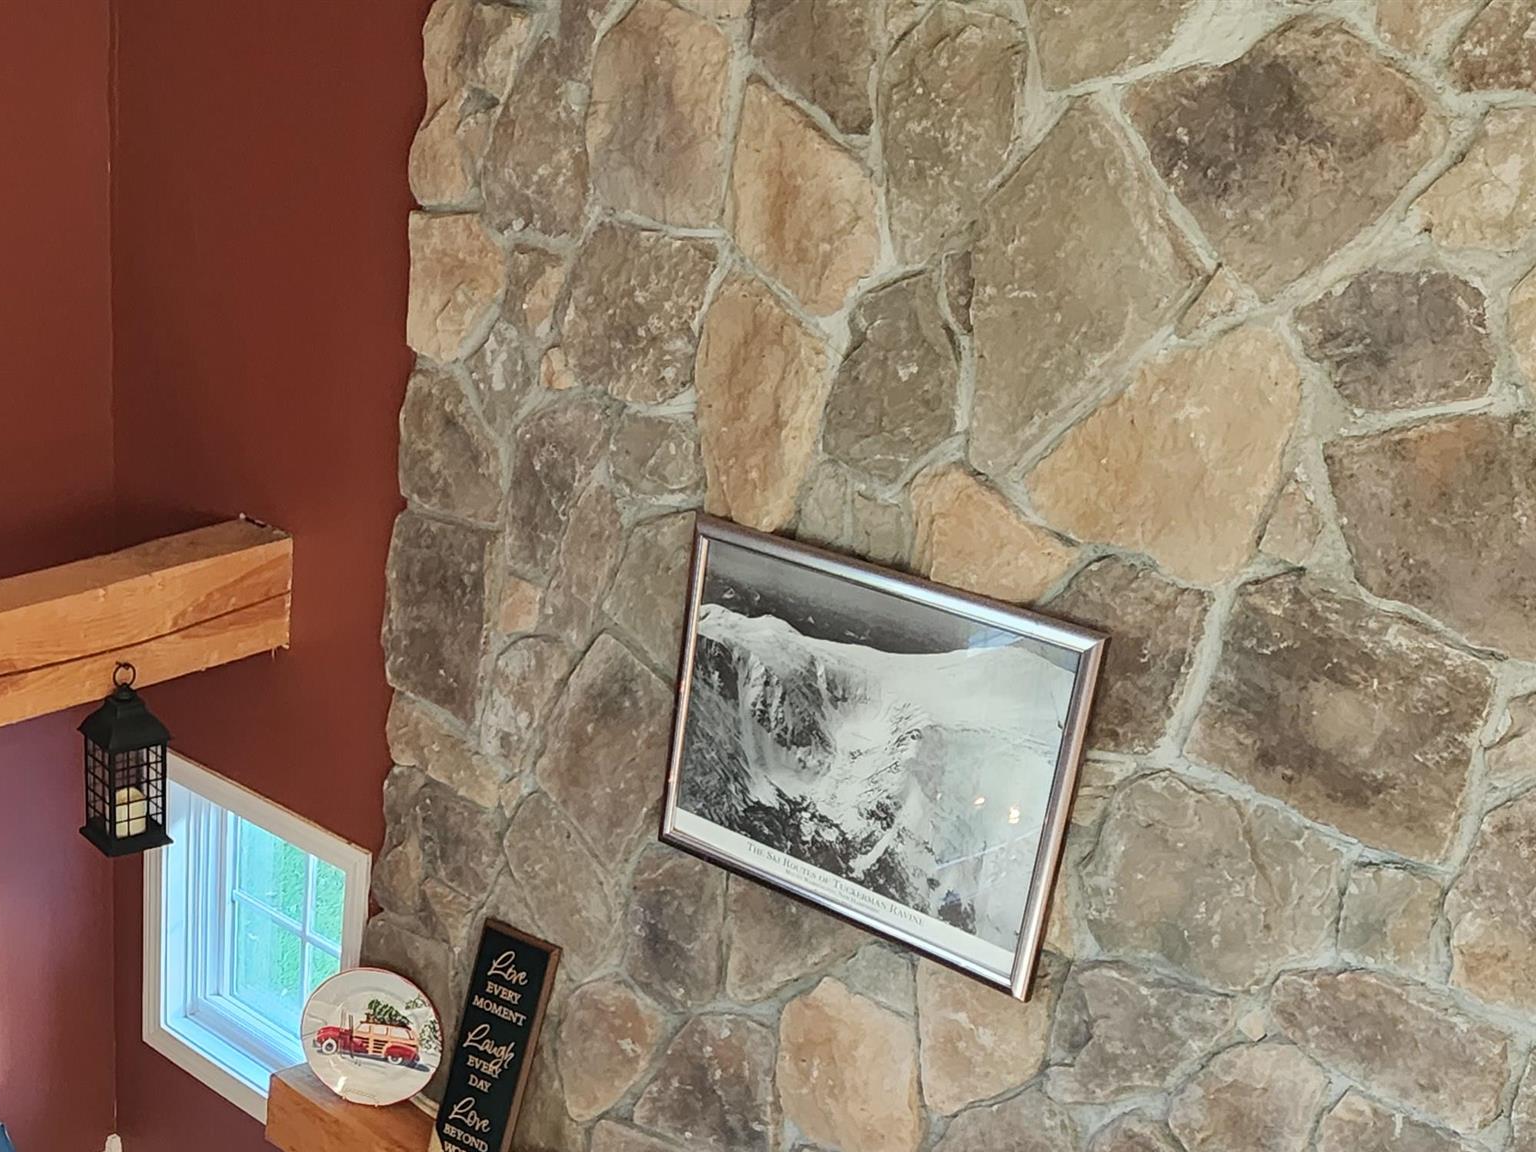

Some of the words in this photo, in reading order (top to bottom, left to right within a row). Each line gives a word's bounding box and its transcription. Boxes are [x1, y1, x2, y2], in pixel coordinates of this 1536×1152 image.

[488, 952, 528, 985] Live
[486, 982, 521, 1004] EVERY
[473, 995, 526, 1026] MOMENT
[463, 1024, 514, 1068] Laugh
[467, 1055, 501, 1078] EVERY
[469, 1075, 491, 1092] DAY
[449, 1097, 490, 1132] Love
[443, 1123, 488, 1152] BEYOND
